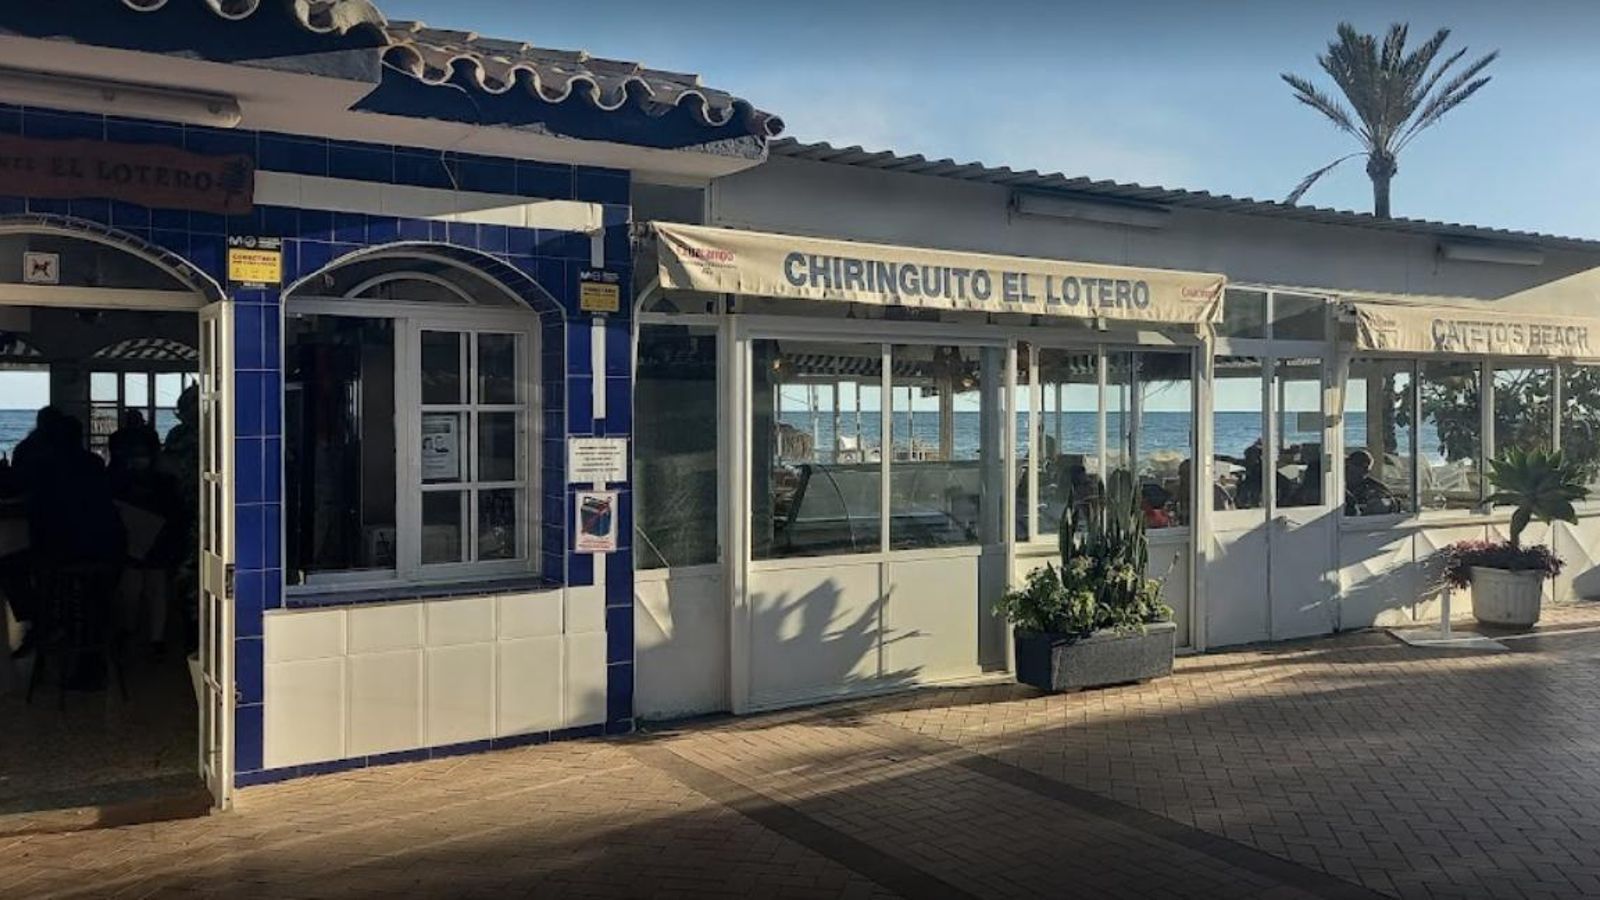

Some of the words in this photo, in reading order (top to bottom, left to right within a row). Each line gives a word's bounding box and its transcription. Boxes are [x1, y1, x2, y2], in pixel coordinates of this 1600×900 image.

[51, 156, 83, 178] EL
[97, 160, 213, 191] LOTERO
[784, 251, 992, 300] CHIRINGUITO
[1002, 272, 1036, 302] EL
[1046, 275, 1150, 309] LOTERO
[1529, 324, 1589, 350] BEACH
